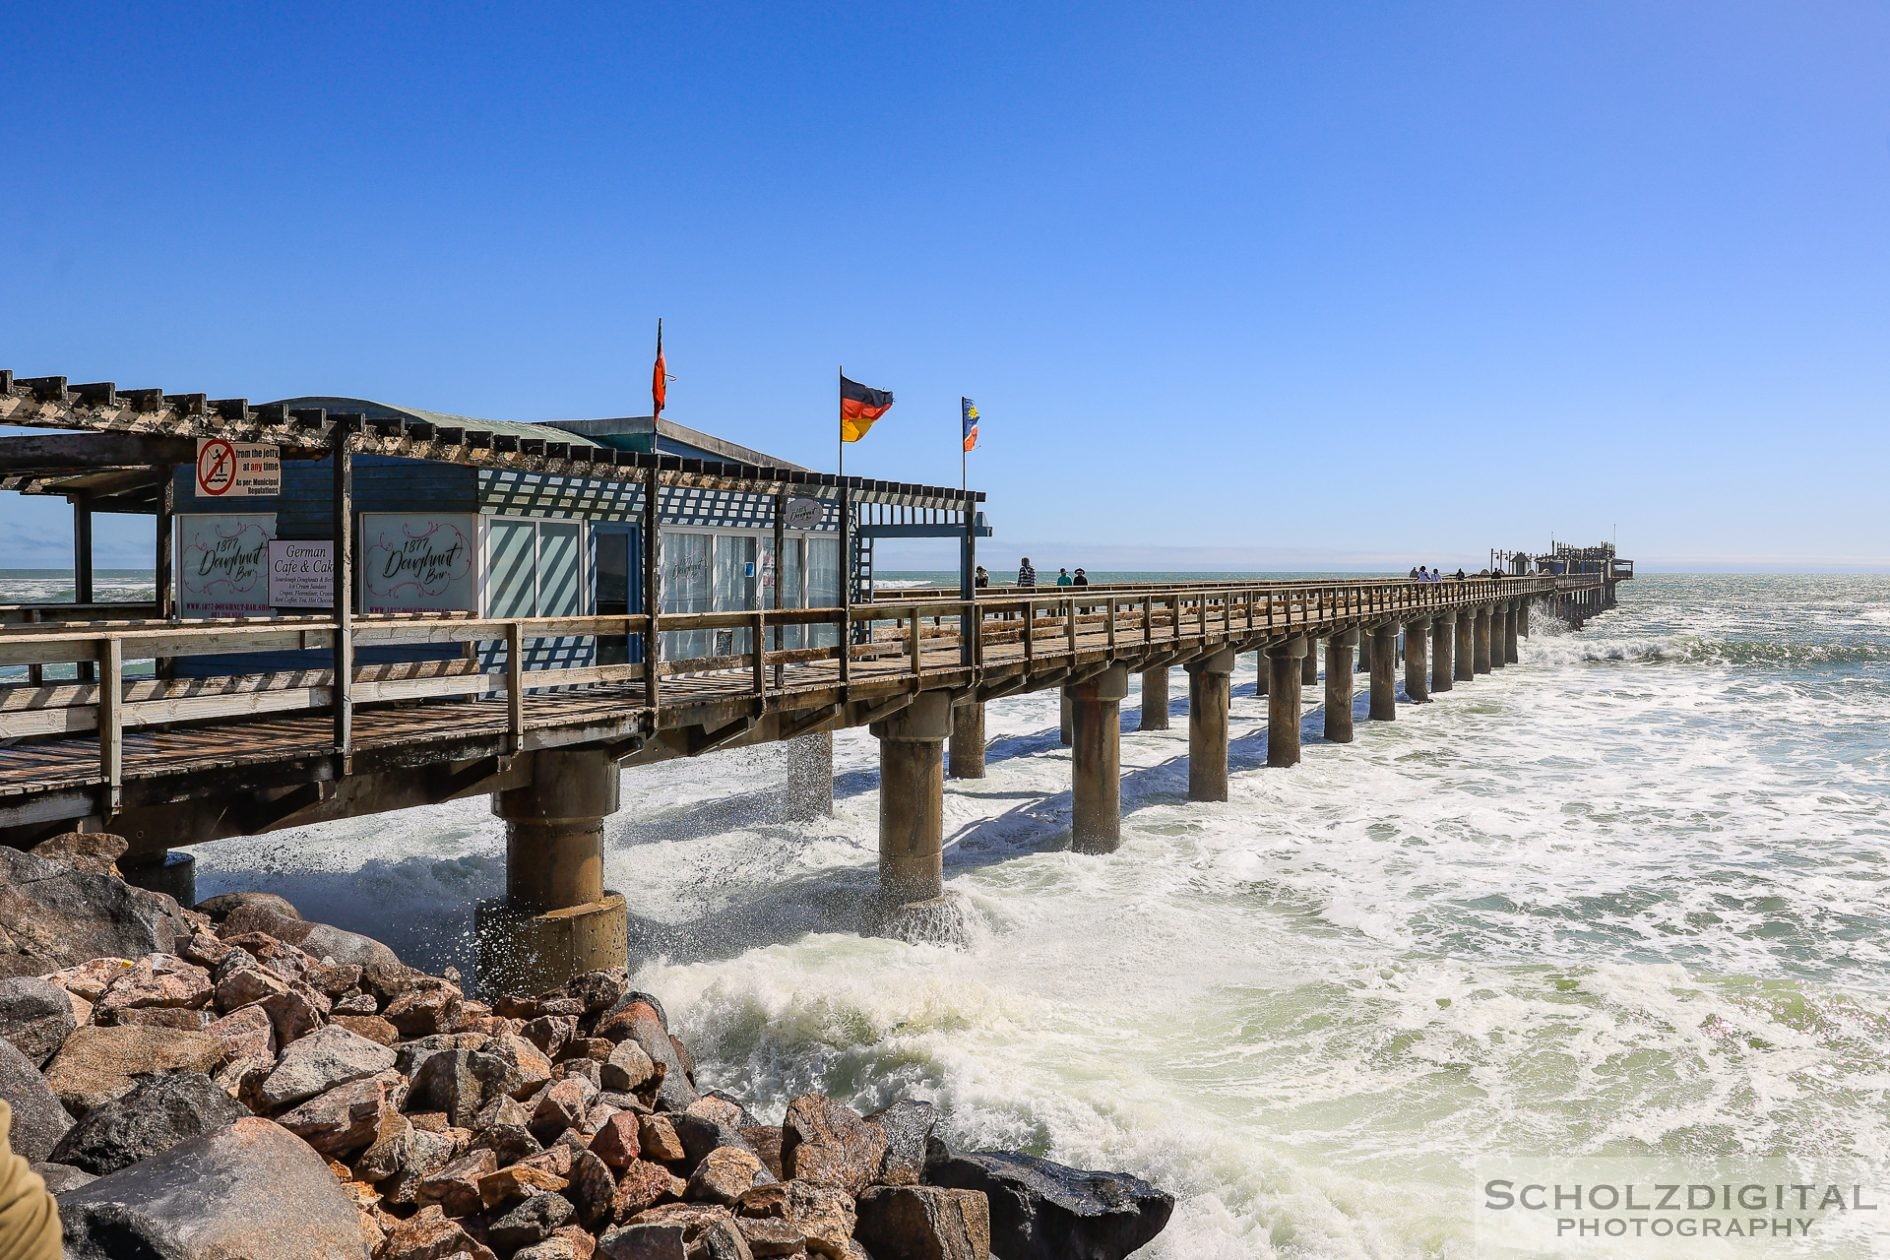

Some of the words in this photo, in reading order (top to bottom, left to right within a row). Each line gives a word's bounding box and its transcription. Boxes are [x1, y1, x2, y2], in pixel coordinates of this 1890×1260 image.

[235, 449, 252, 458] from
[252, 449, 262, 458] the
[263, 448, 278, 459] jetty
[242, 463, 250, 471] at
[251, 463, 263, 473] any
[263, 462, 279, 471] time
[253, 478, 279, 486] Municipal
[247, 486, 279, 495] Regulations
[216, 538, 239, 552] 1877
[286, 544, 326, 558] German
[403, 537, 430, 553] 1877
[198, 542, 268, 576] Doughnut
[383, 542, 463, 578] Doughnut
[234, 566, 255, 582] Bar
[274, 559, 298, 575] Cafe
[300, 559, 310, 573] &
[313, 559, 334, 573] Cak
[423, 567, 448, 585] Bar
